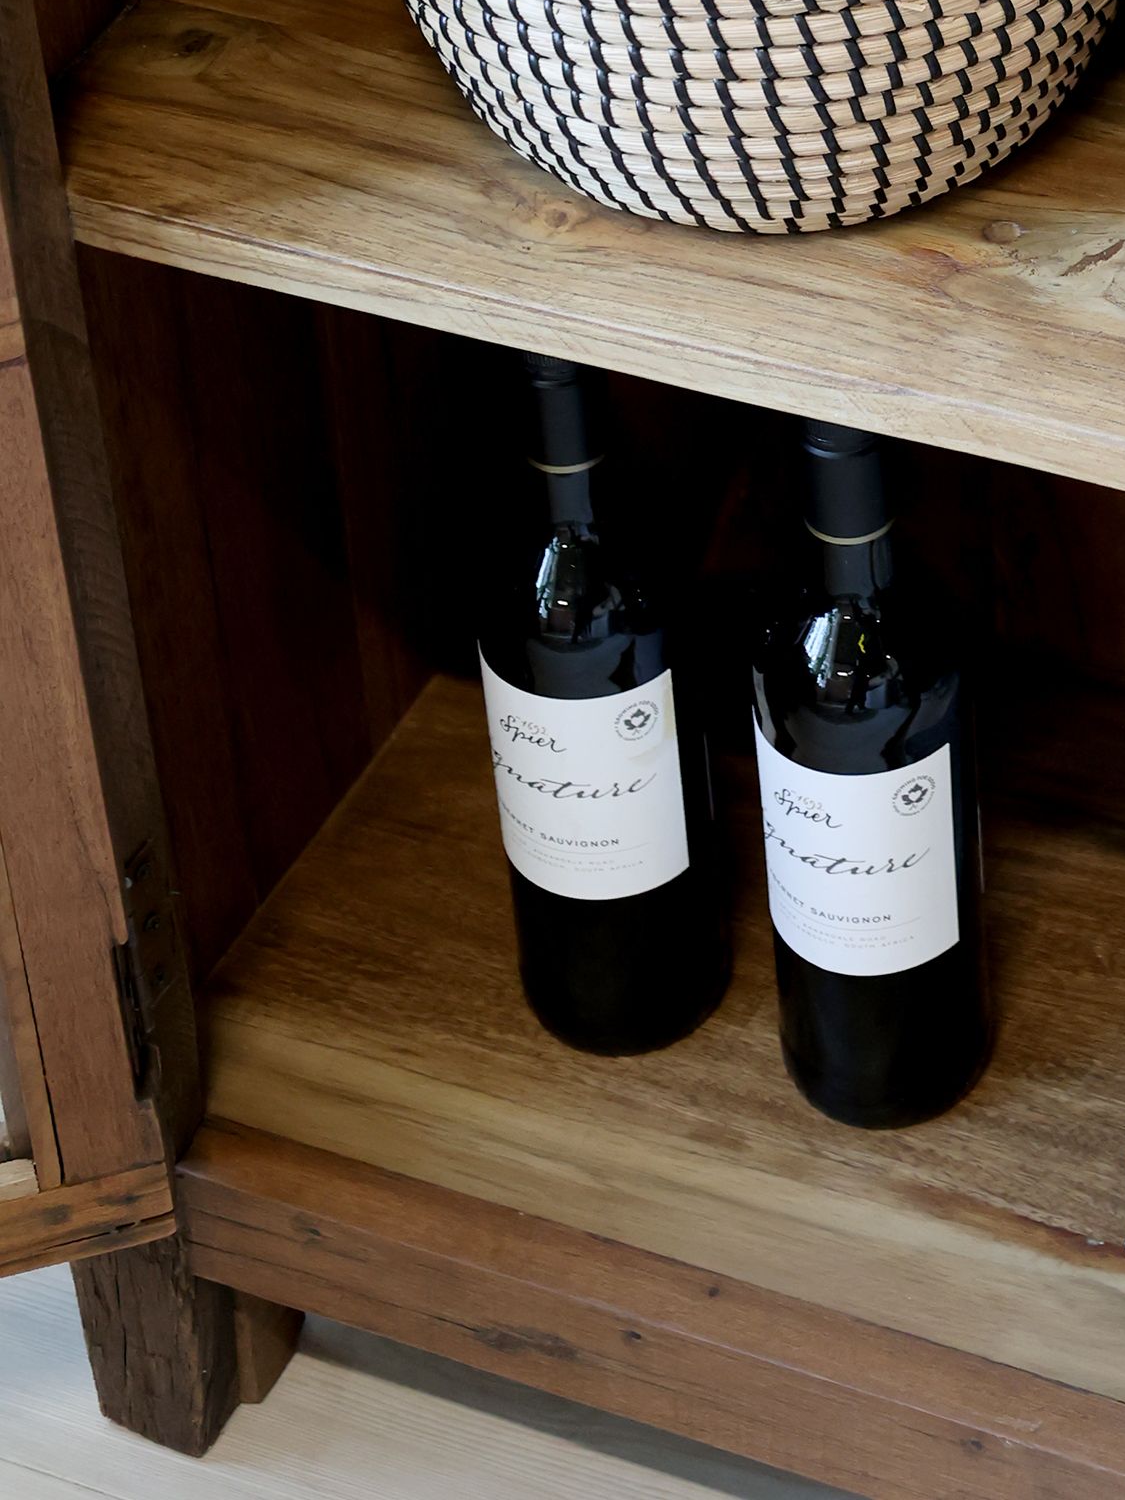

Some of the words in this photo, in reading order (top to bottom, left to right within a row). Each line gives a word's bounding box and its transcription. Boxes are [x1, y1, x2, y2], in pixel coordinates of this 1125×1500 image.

[499, 714, 568, 753] Spier
[491, 748, 658, 799] gnature
[773, 788, 843, 829] Spier
[539, 832, 620, 848] SAUVIGNON
[763, 820, 930, 875] gnature
[809, 907, 893, 925] SAUVIGNON
